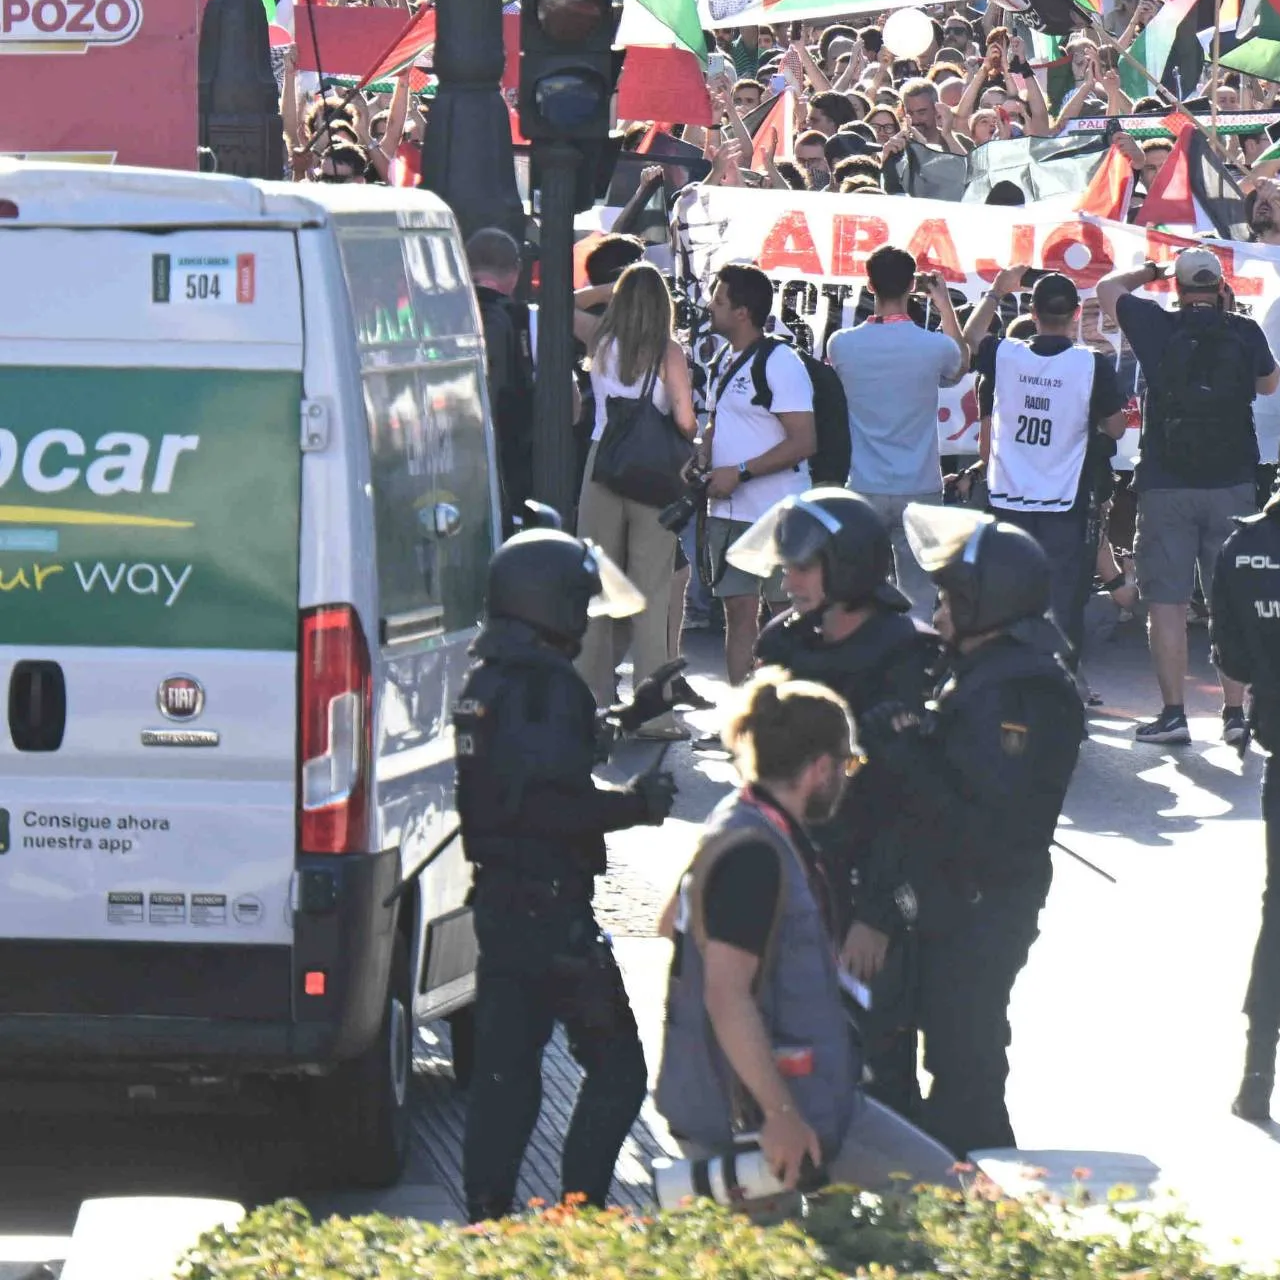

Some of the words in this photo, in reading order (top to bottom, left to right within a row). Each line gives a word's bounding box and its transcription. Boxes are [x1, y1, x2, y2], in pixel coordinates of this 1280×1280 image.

[759, 210, 1115, 288] ABAJO
[186, 274, 221, 299] 504
[1024, 394, 1050, 410] RADIO
[1015, 415, 1053, 446] 209
[74, 561, 193, 607] way
[168, 687, 195, 709] FIAT
[23, 810, 112, 832] Consigue
[117, 814, 171, 831] ahora
[23, 834, 93, 850] nuestra
[98, 839, 133, 854] app
